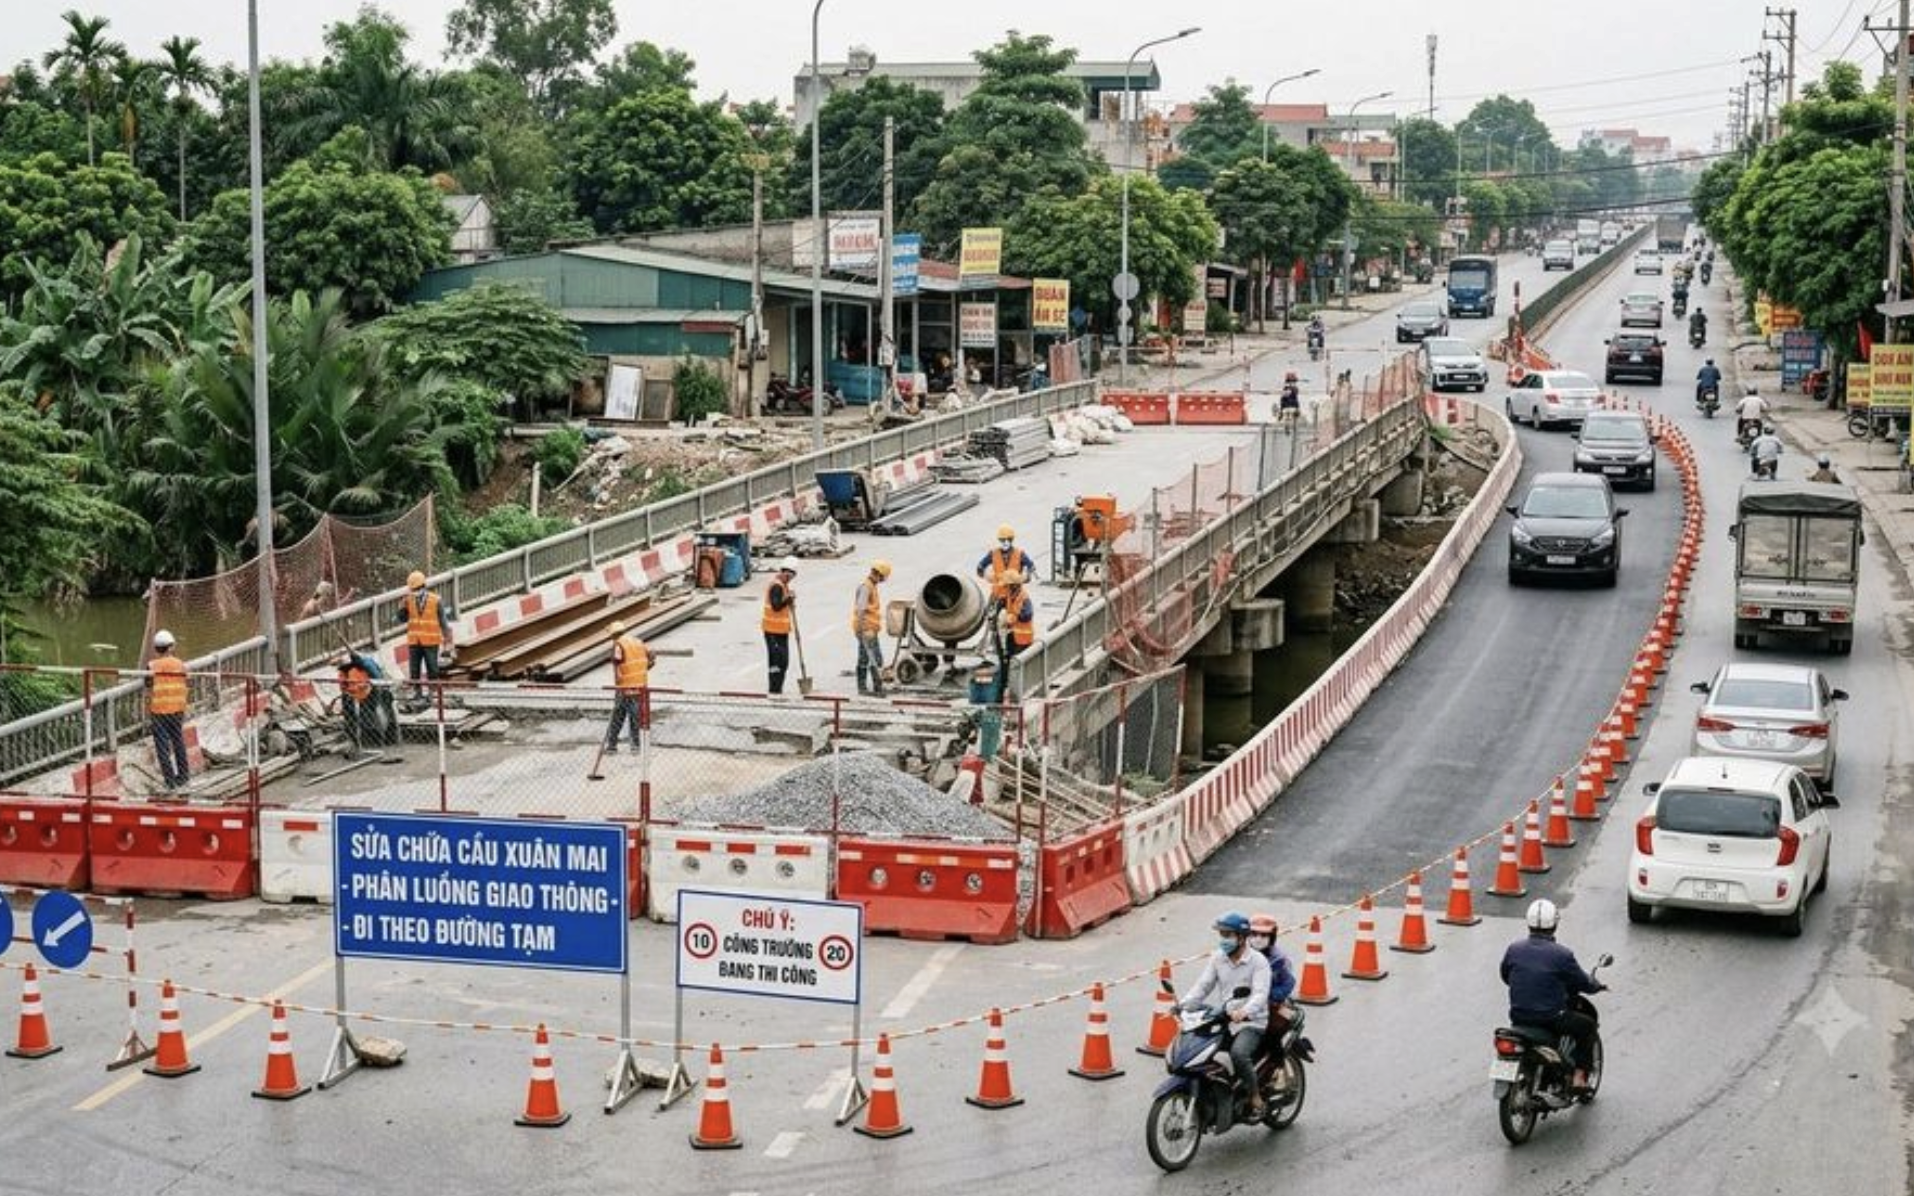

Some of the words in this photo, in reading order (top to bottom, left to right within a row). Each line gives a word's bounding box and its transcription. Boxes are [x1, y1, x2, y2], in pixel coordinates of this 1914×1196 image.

[351, 824, 392, 860] SỬA
[397, 830, 453, 864] CHỮA
[504, 836, 560, 870] XUÂN
[567, 844, 608, 873] MAI
[486, 881, 534, 910] GIAO
[378, 916, 430, 943] THEO
[510, 922, 556, 956] TẠM
[692, 933, 711, 950] 10
[826, 944, 846, 962] 20
[758, 964, 778, 983] THI
